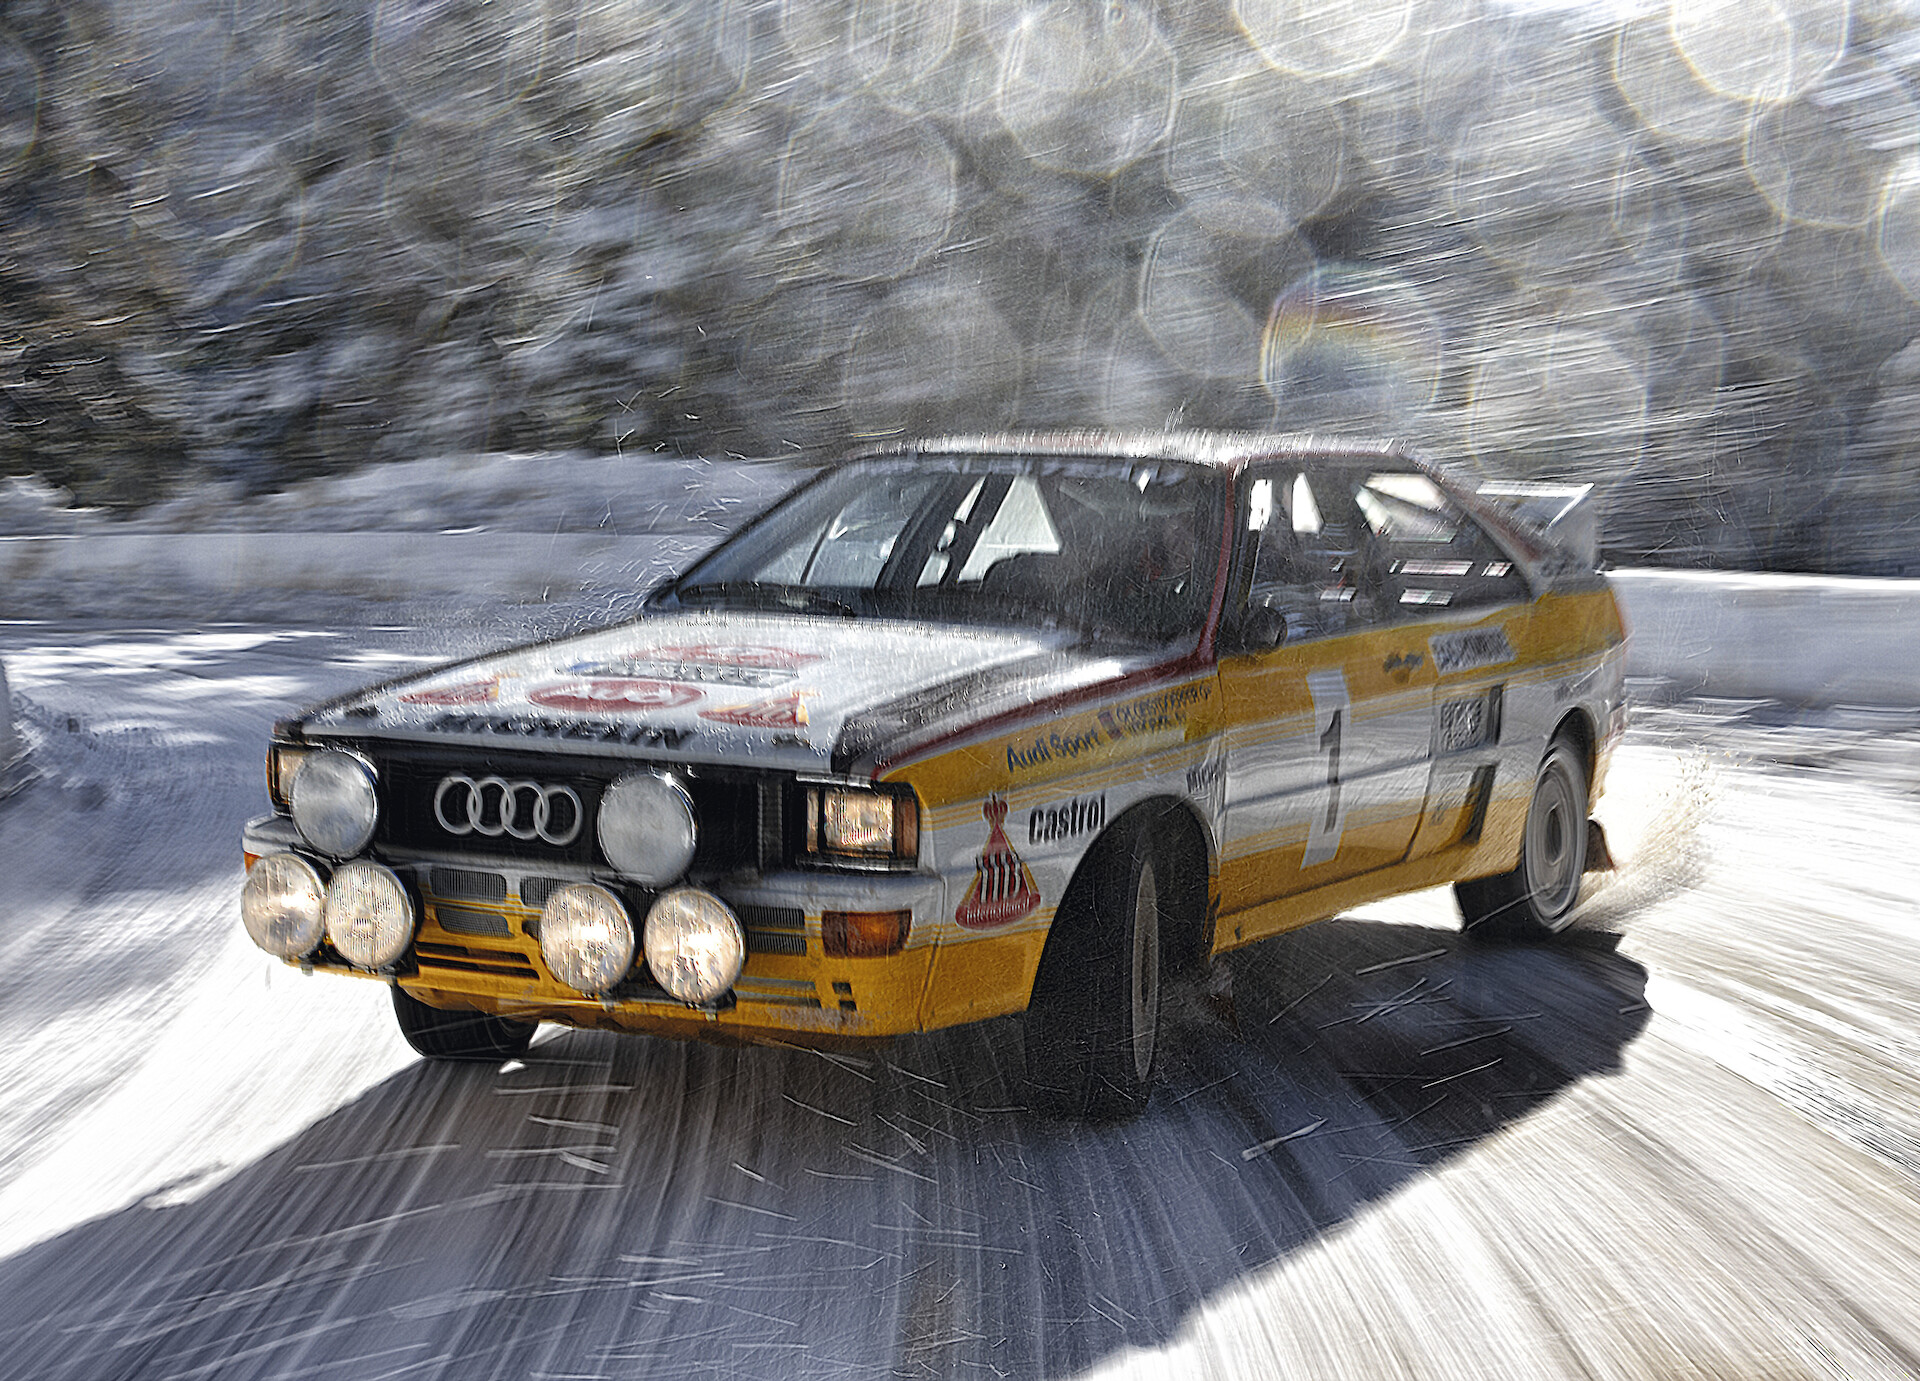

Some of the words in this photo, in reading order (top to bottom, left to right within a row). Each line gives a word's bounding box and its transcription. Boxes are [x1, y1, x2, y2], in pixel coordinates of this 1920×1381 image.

[1006, 735, 1052, 773] Audi
[1050, 728, 1101, 759] Sport
[1319, 708, 1342, 834] 1
[1029, 793, 1106, 845] Castrol
